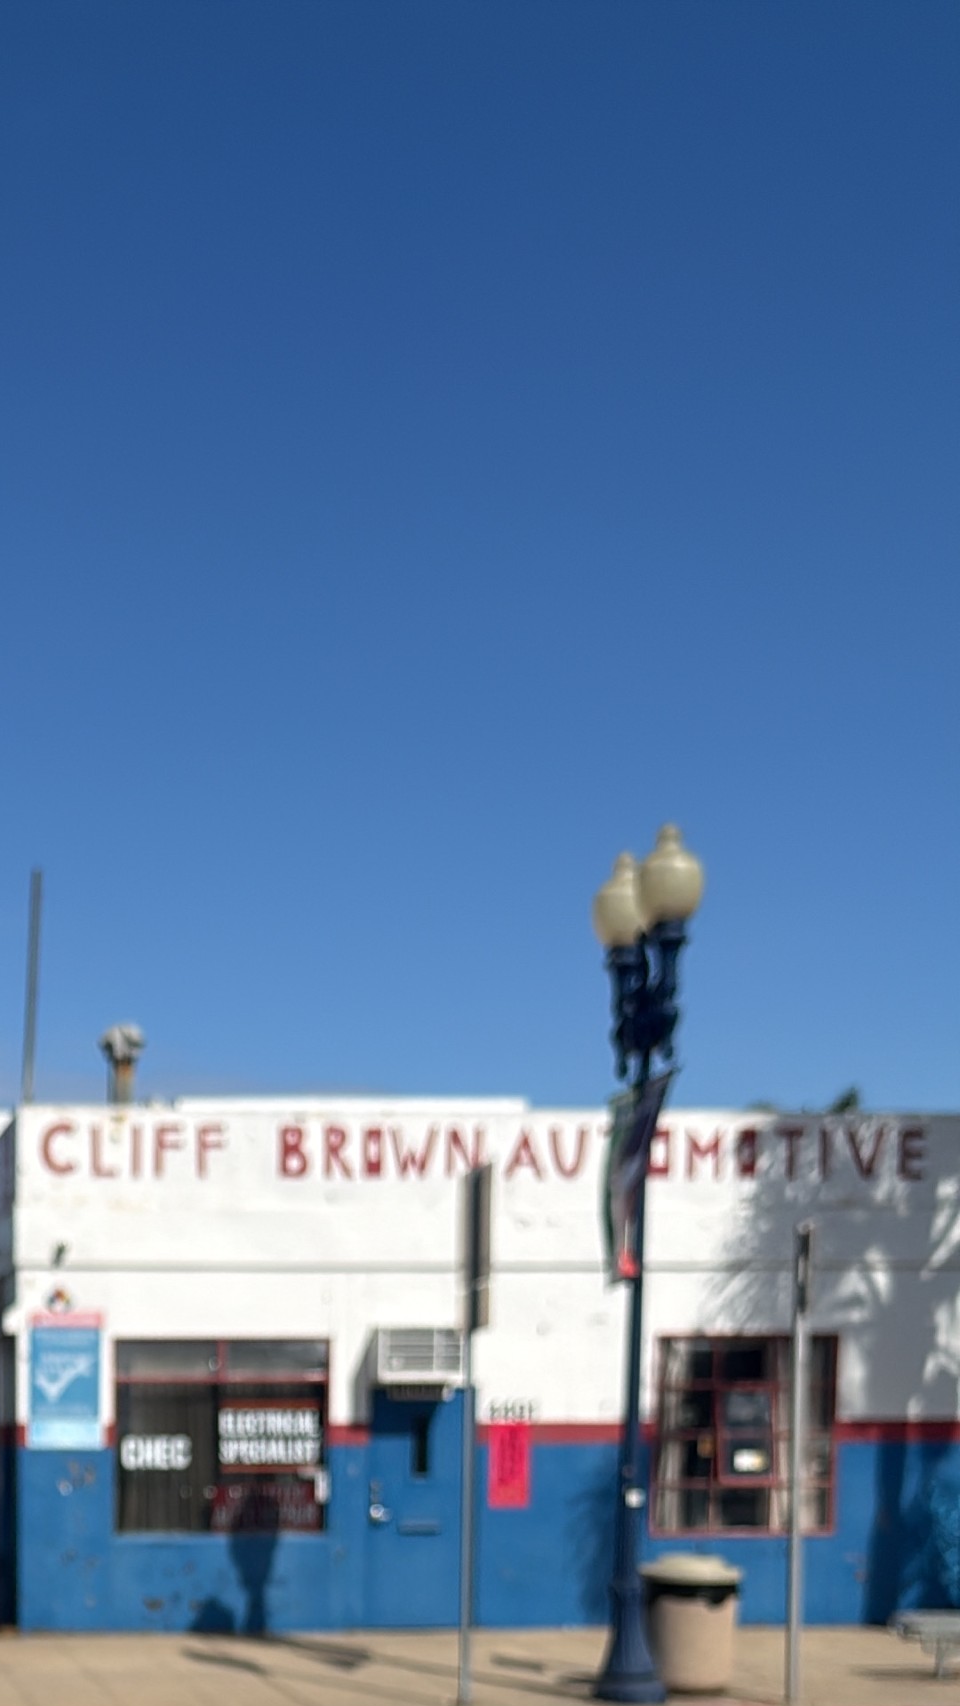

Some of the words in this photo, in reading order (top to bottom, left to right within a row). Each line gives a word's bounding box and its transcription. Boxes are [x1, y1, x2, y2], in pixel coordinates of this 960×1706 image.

[40, 1122, 228, 1178] CLIFF
[276, 1123, 487, 1179] BROWN
[501, 1124, 928, 1181] AUOMOTIVE
[219, 1438, 320, 1464] SPECIALIST
